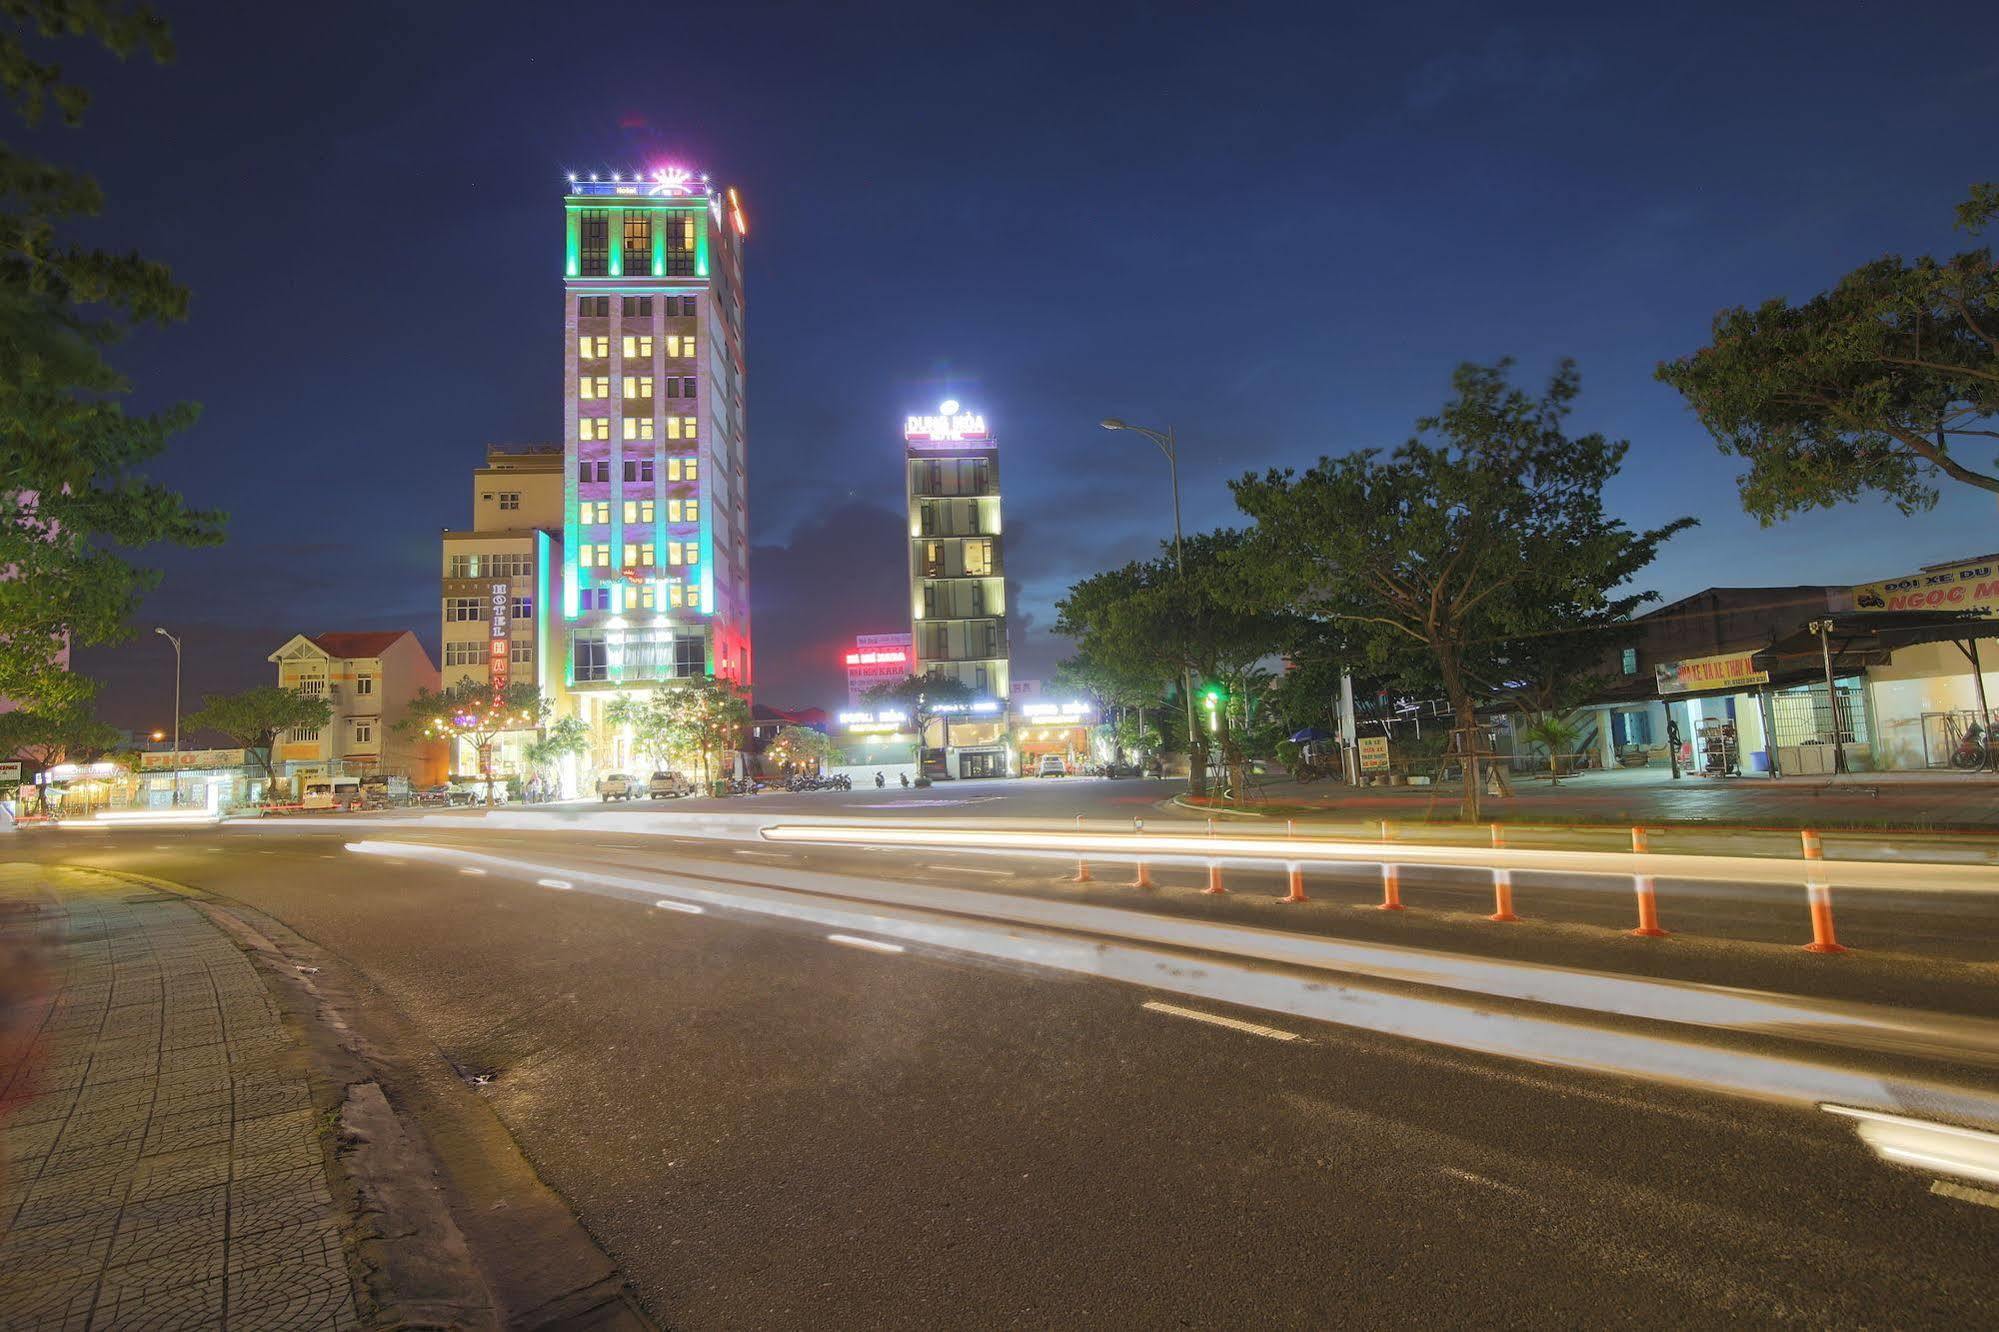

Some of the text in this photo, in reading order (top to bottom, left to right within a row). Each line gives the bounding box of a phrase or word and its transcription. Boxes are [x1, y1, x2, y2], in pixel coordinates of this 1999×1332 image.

[1925, 574, 1954, 585] XE
[1960, 567, 1992, 580] DU
[492, 583, 507, 637] HOTEL
